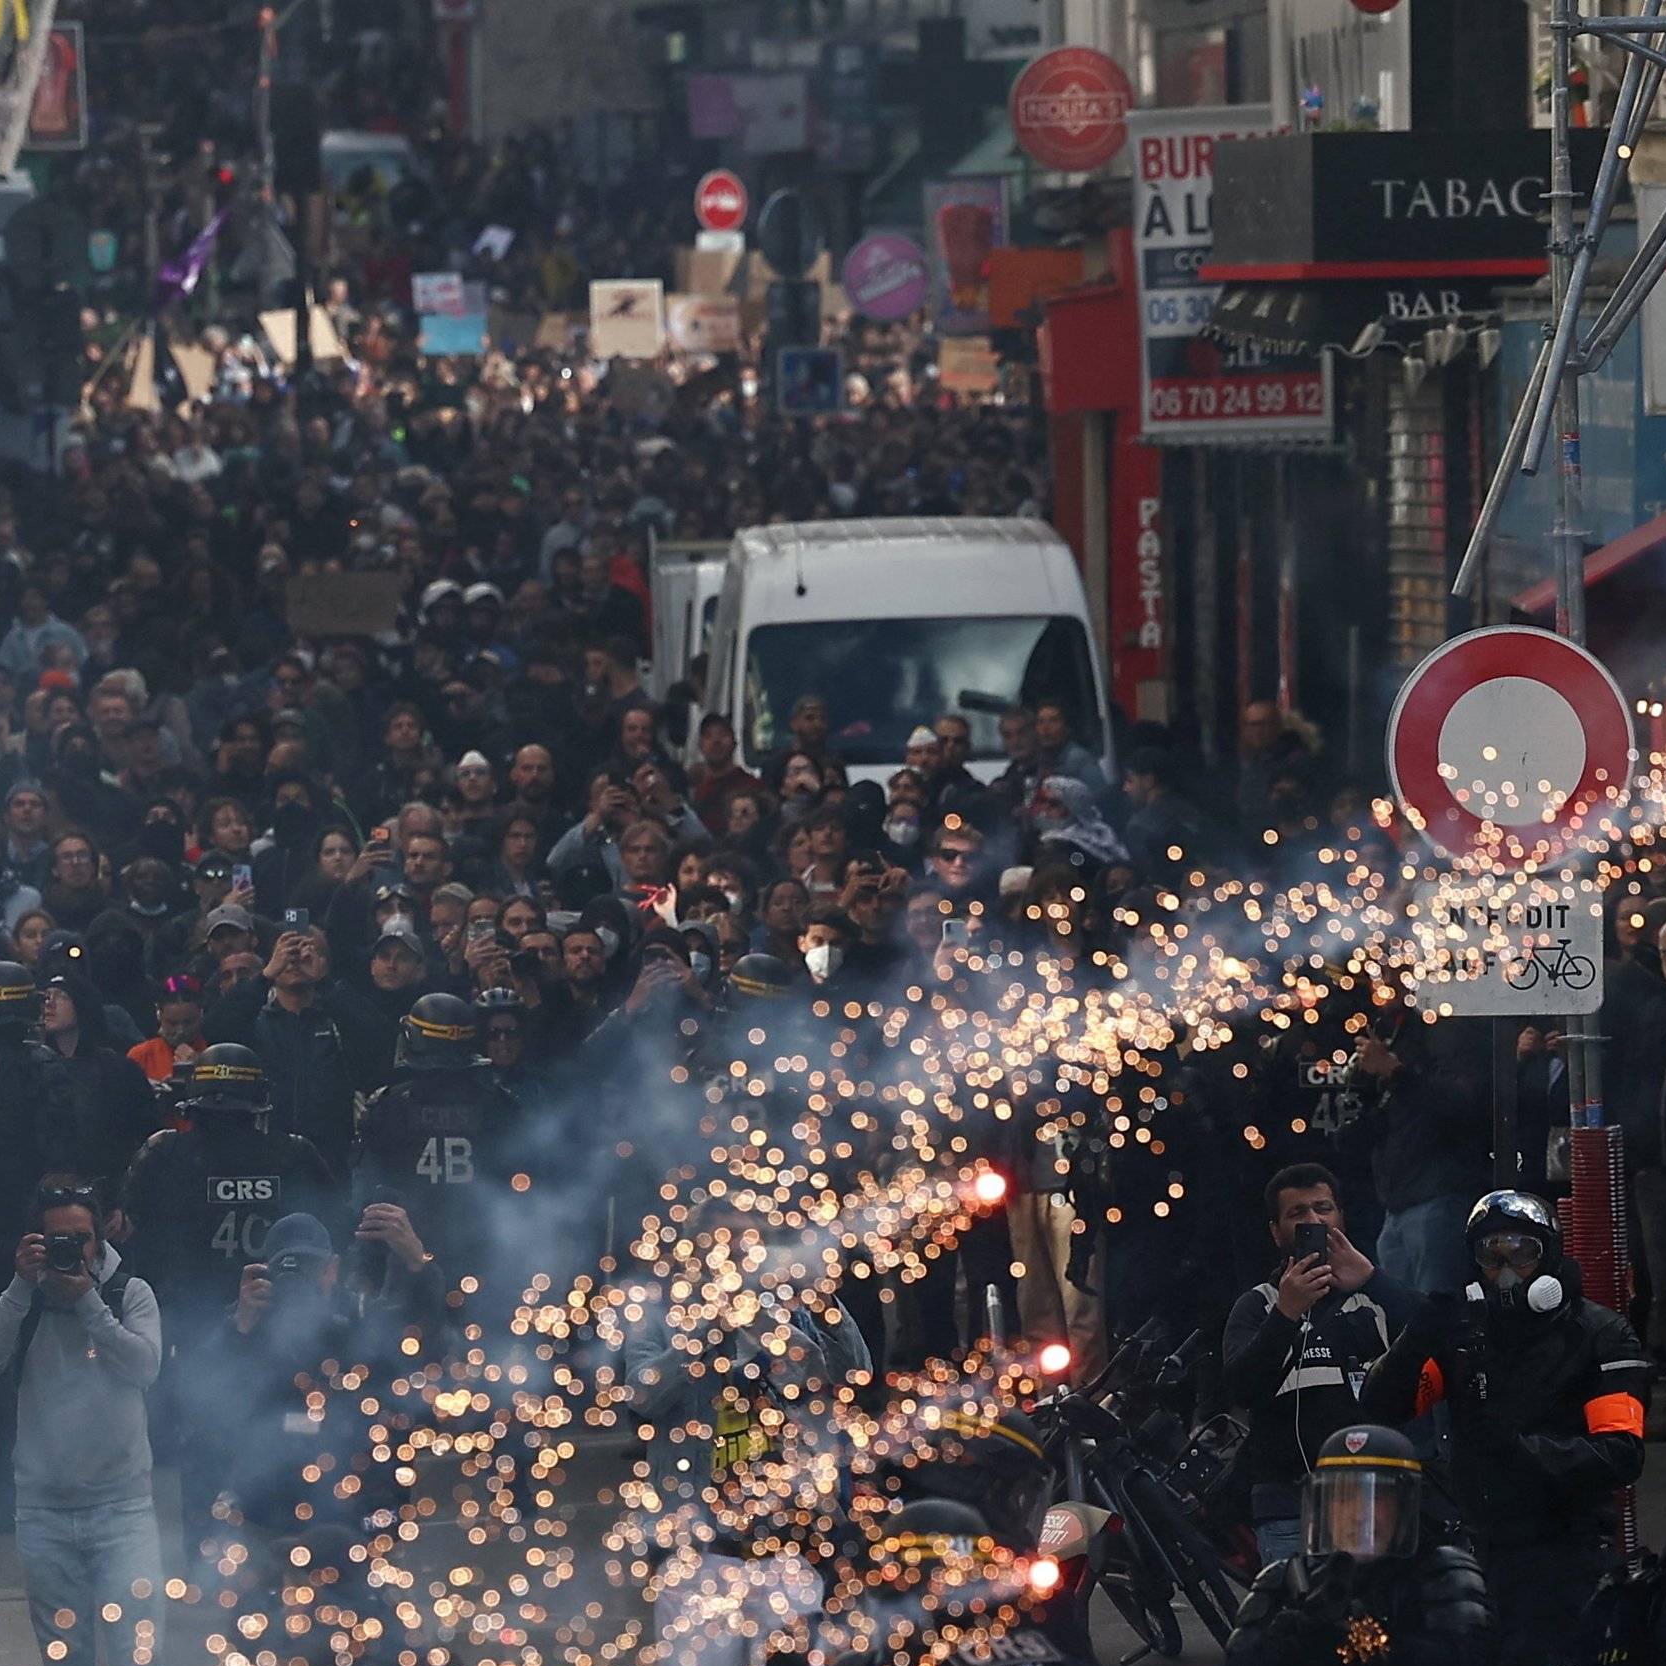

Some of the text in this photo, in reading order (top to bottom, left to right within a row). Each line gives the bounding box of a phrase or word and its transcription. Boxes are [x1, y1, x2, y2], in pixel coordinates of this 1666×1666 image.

[1143, 183, 1214, 238] À L
[1372, 176, 1545, 219] TABAC
[1387, 291, 1463, 319] BAR
[1151, 382, 1321, 417] 06 70 24 99 12
[1137, 498, 1161, 648] PASTA
[1306, 1065, 1346, 1085] CR
[415, 1136, 475, 1185] 4B
[216, 1179, 273, 1200] CRS
[1299, 1347, 1333, 1360] RESSE
